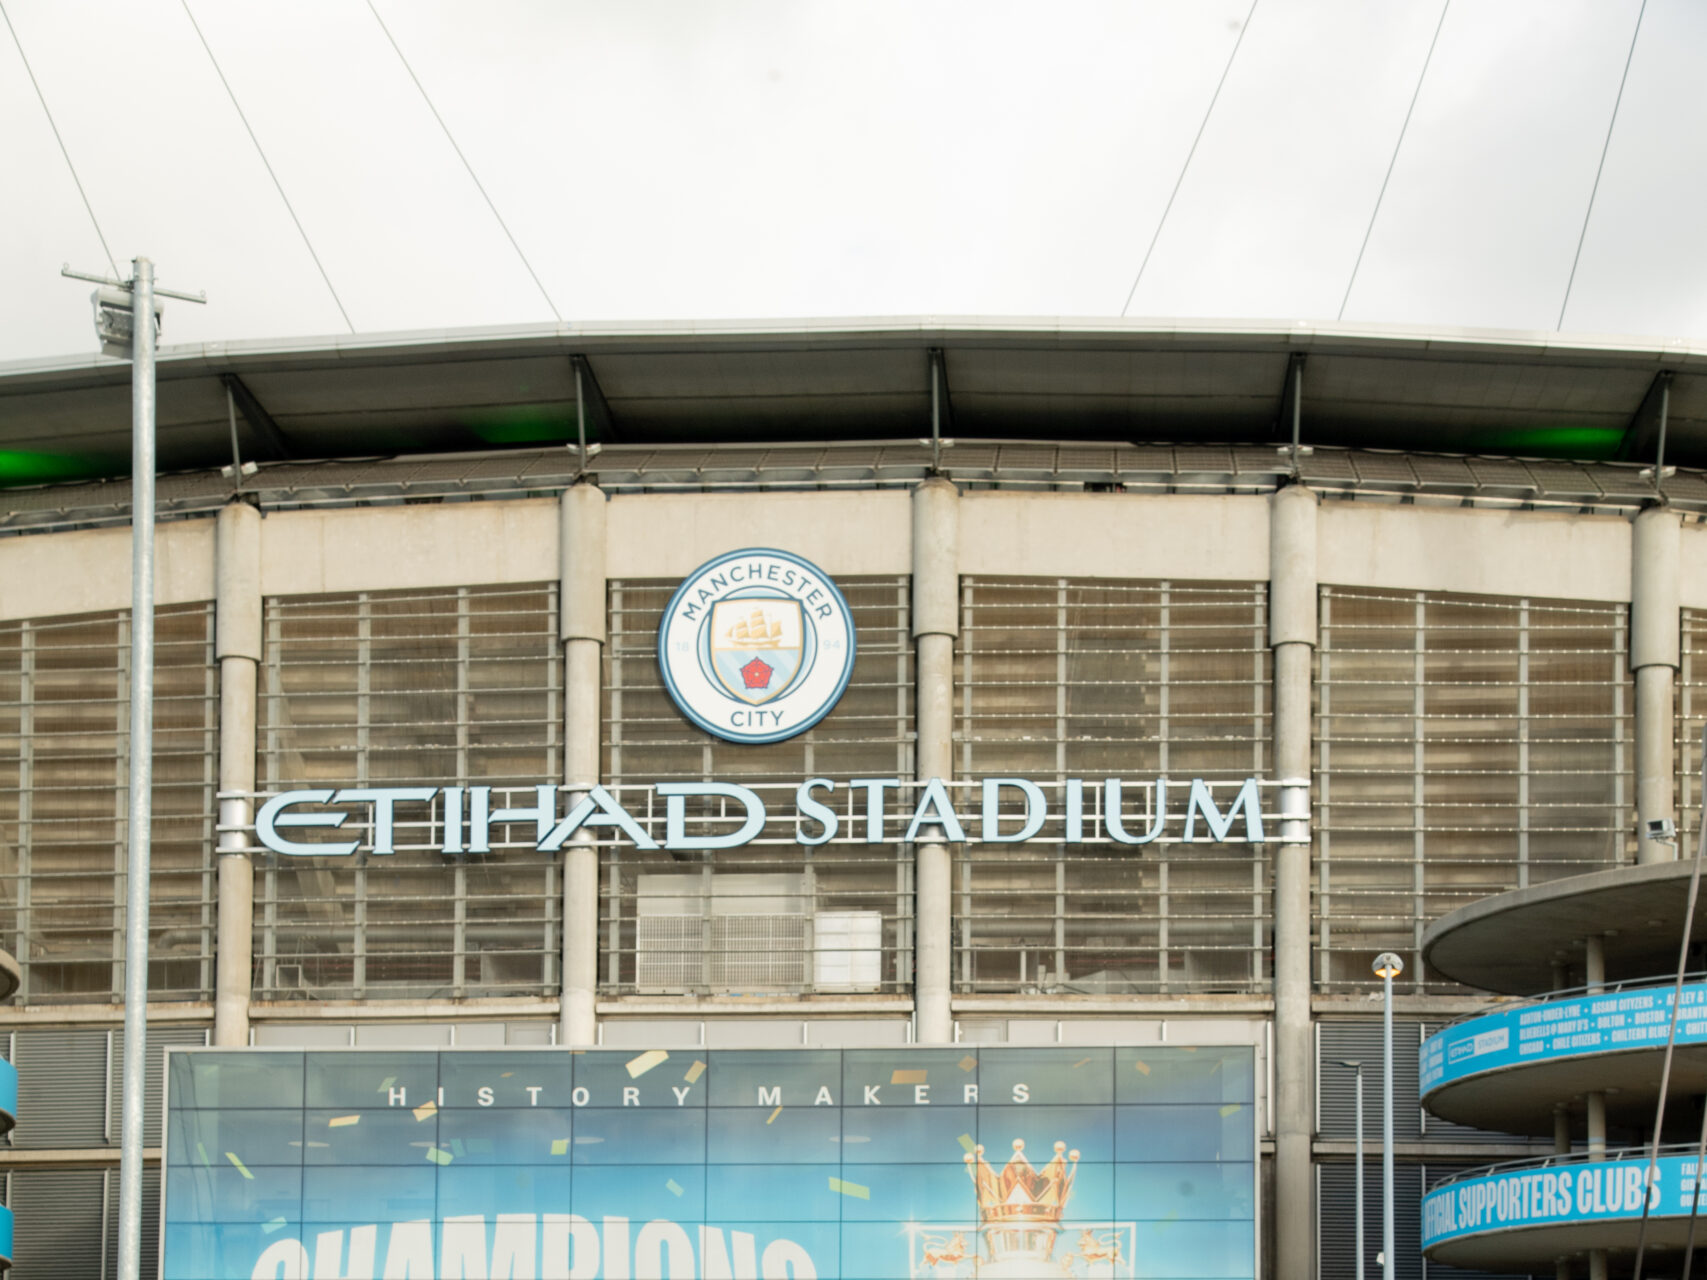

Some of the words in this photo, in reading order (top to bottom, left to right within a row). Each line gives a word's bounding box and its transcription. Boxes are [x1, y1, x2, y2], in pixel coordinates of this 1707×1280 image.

[683, 563, 833, 622] MANCHESTER
[822, 639, 841, 650] 94
[730, 710, 785, 728] CITY
[254, 782, 767, 856] ETIHAD
[796, 776, 1265, 846] STADIUM
[388, 1087, 690, 1107] HISTORY
[757, 1083, 1030, 1106] MAKERS
[1458, 1171, 1573, 1230] SUPPORTERS
[1576, 1165, 1662, 1214] CLUBS
